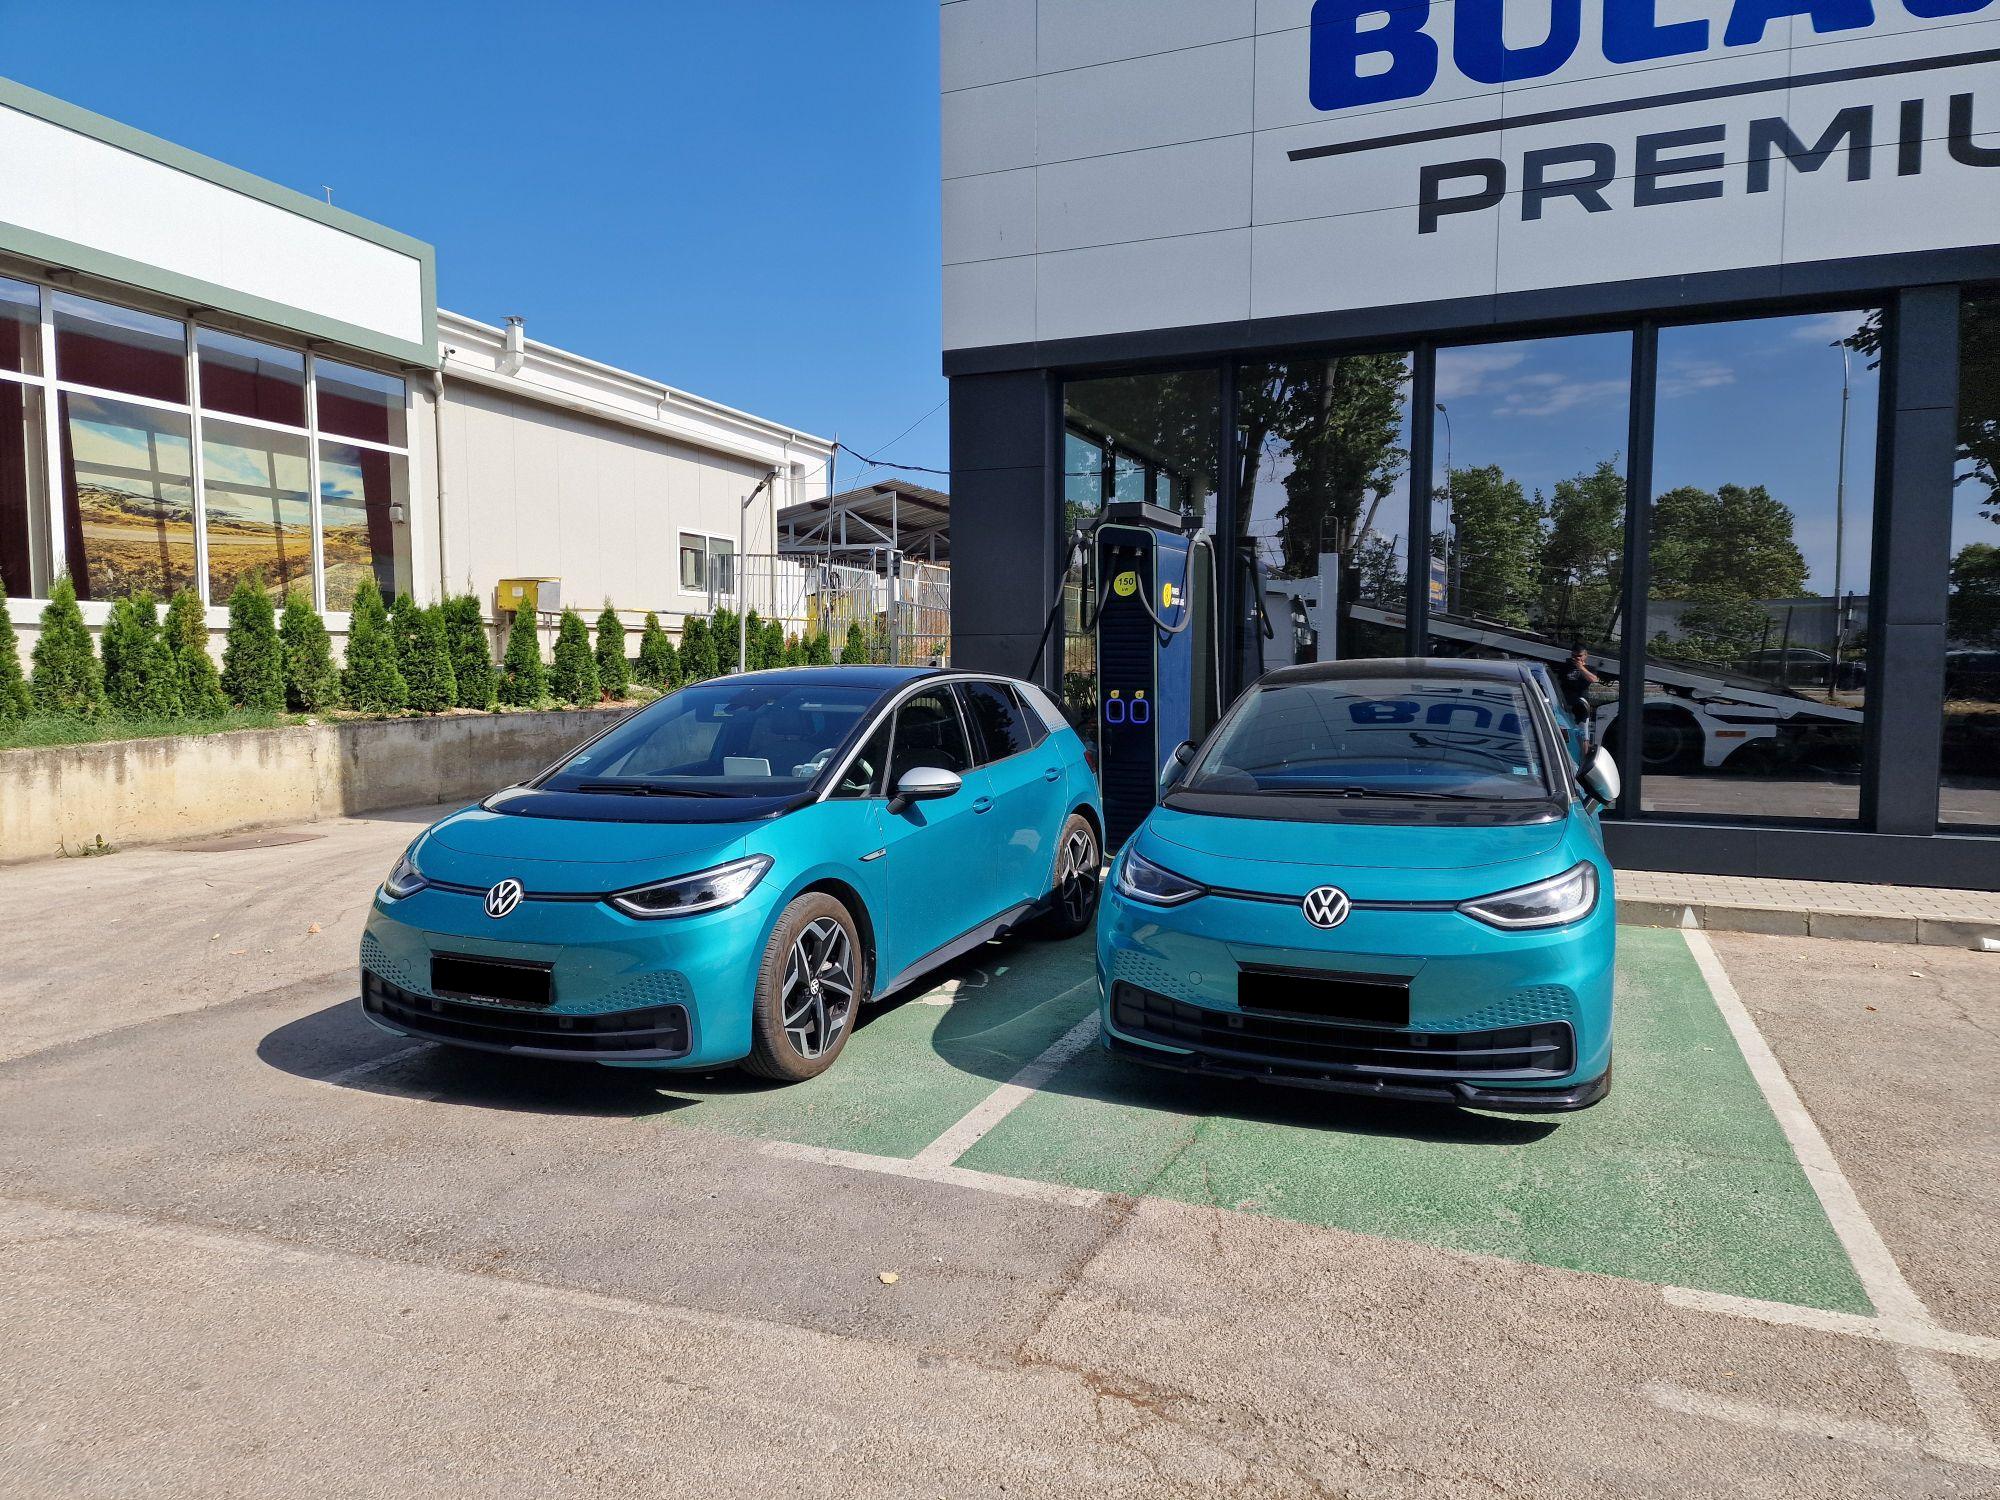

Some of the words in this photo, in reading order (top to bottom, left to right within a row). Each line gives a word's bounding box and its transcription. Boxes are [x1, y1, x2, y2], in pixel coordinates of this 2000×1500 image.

[1309, 0, 1995, 111] BULA
[1119, 577, 1134, 586] 150
[1303, 886, 1350, 928] VW
